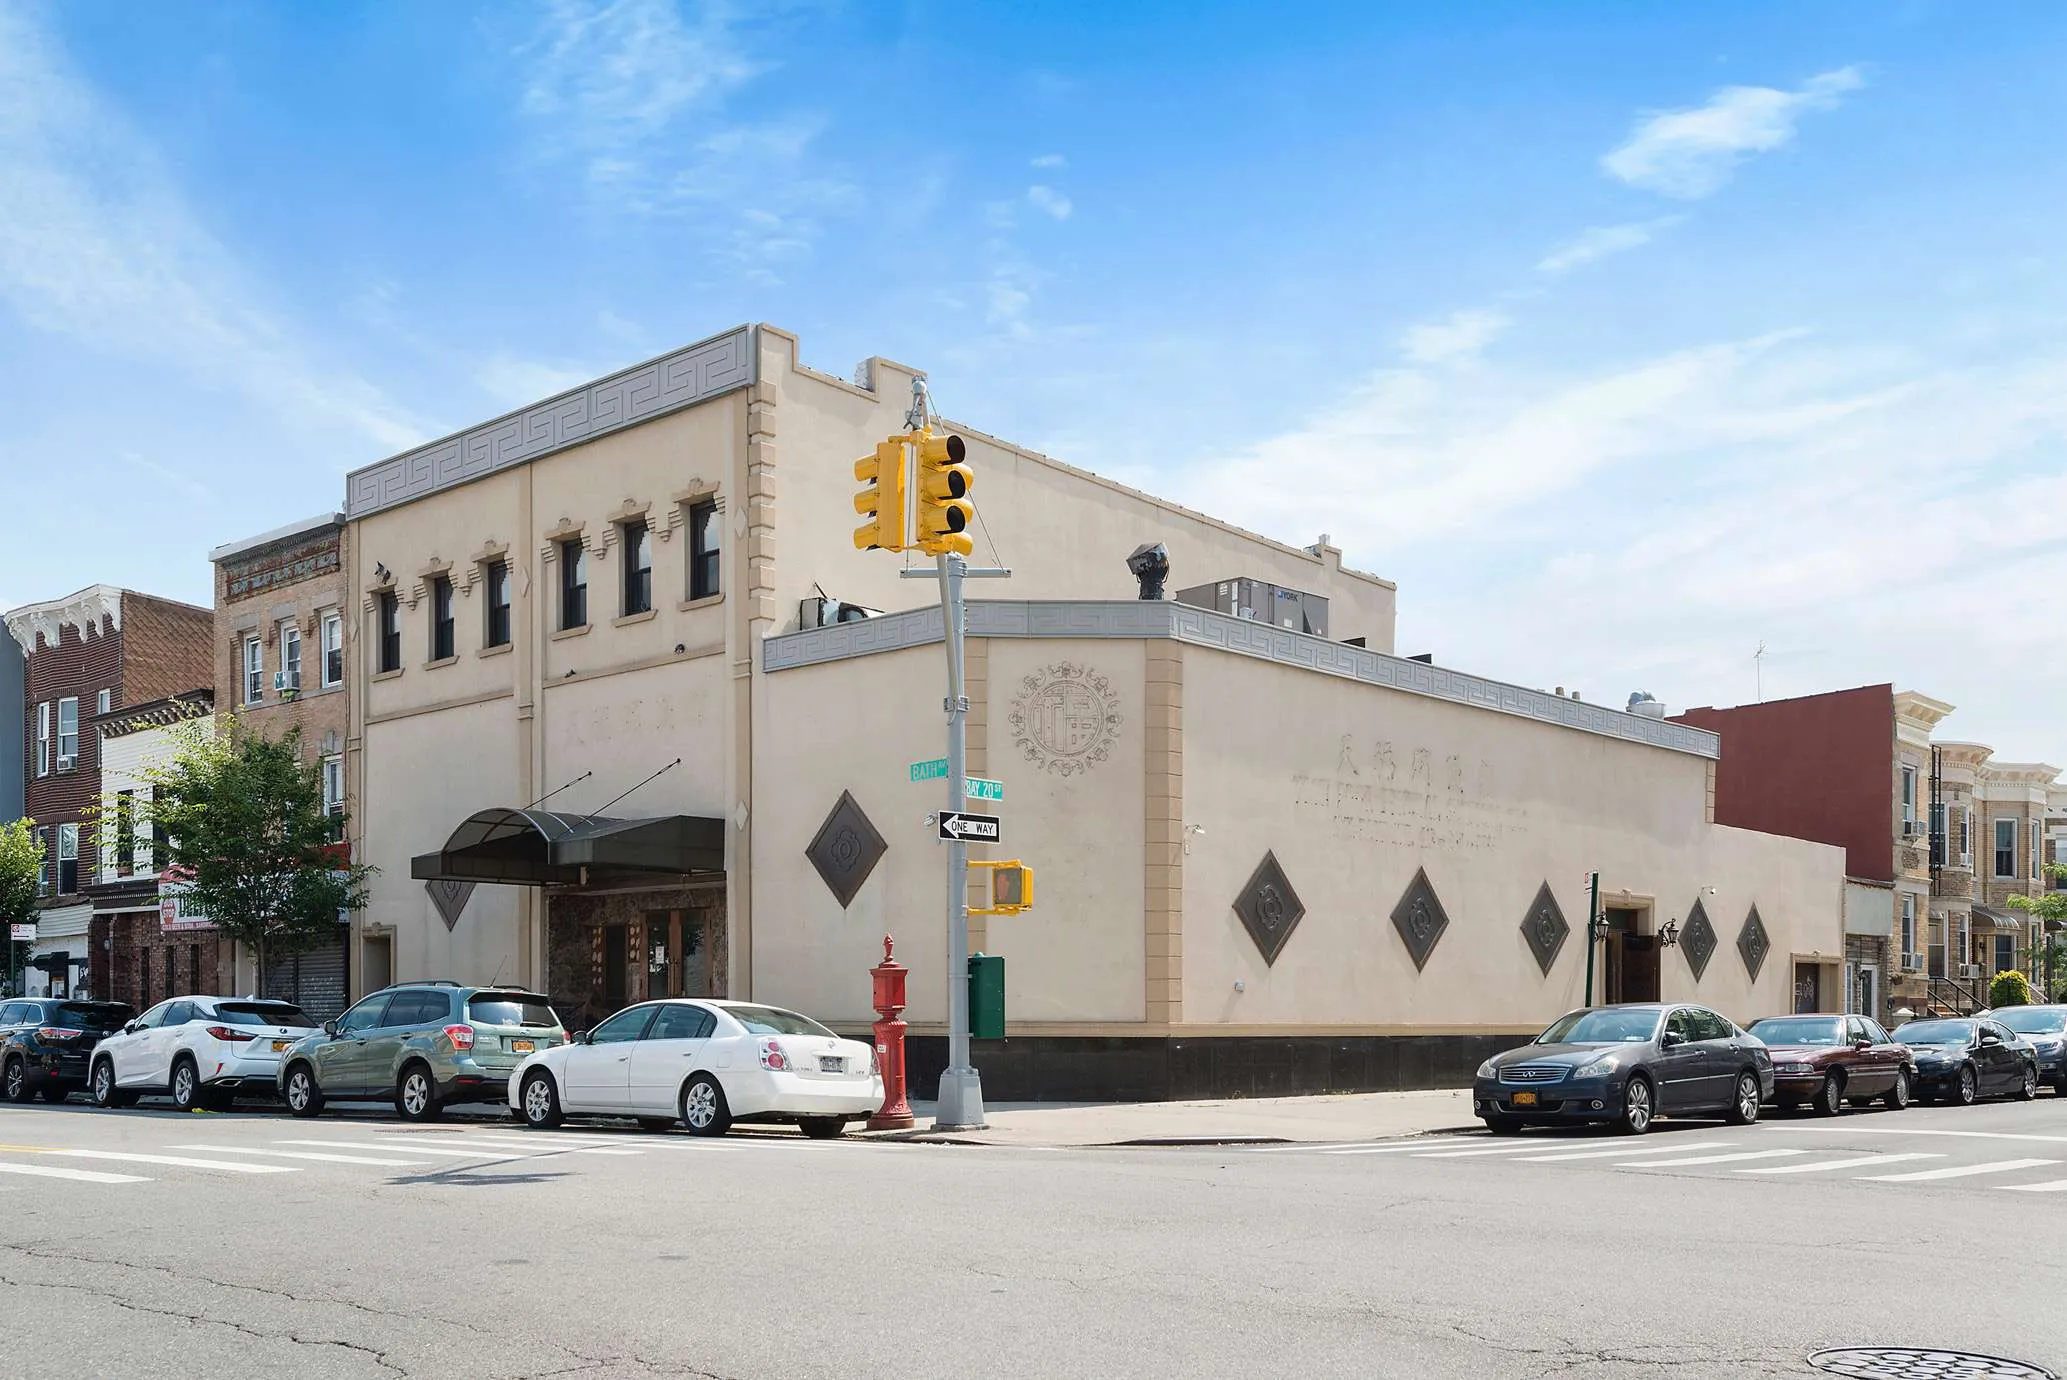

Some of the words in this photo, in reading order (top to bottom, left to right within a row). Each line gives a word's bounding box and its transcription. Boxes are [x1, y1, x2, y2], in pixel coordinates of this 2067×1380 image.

[912, 762, 937, 781] BATH
[966, 780, 980, 797] BAY
[983, 783, 994, 798] 20
[994, 784, 1002, 793] ST
[951, 821, 968, 832] ONE
[976, 823, 993, 835] WAY
